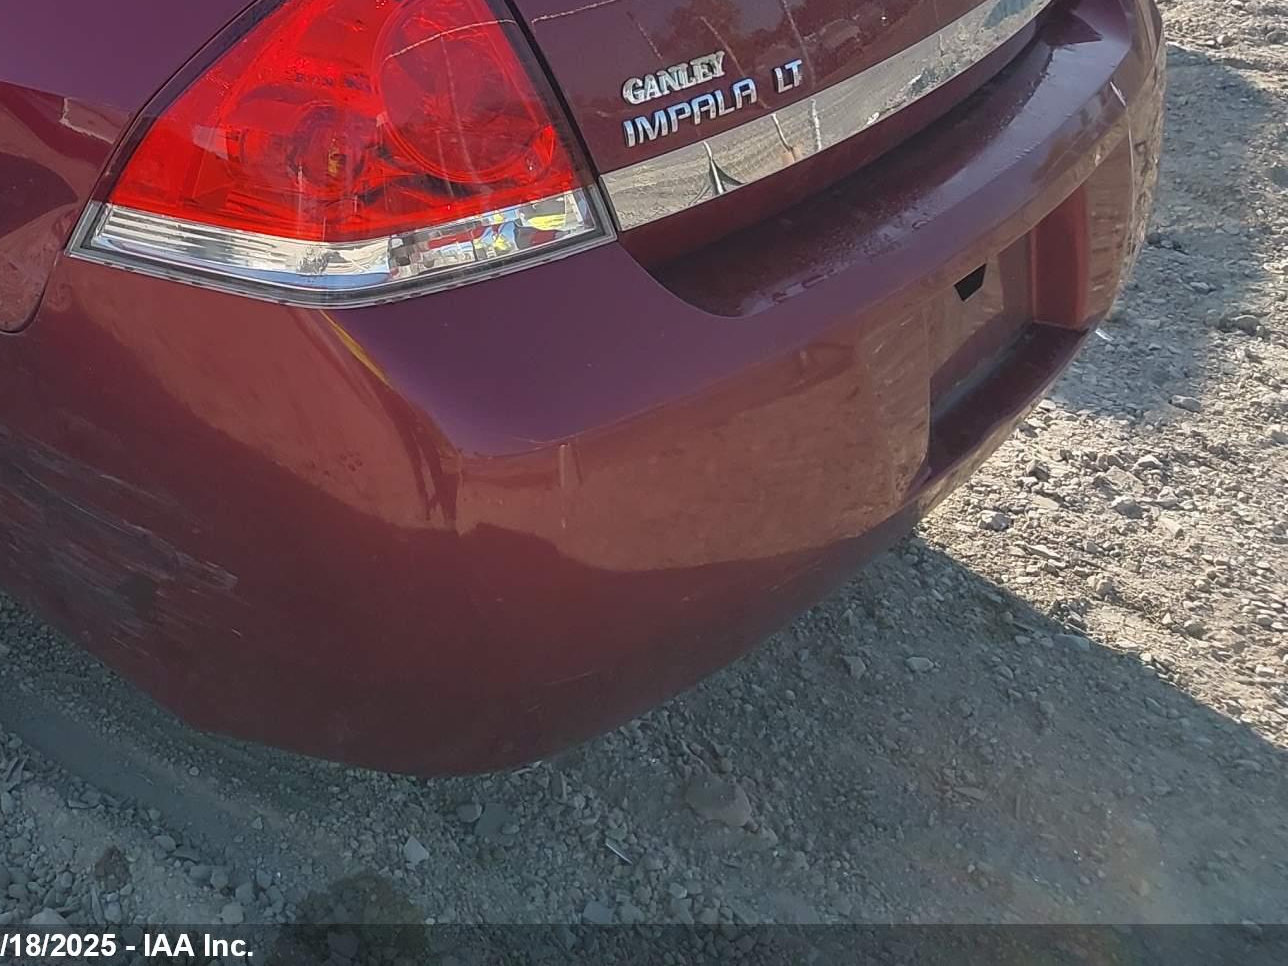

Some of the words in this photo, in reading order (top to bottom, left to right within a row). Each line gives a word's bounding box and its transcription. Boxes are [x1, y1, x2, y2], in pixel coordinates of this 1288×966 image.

[622, 50, 725, 105] GANLEY
[622, 77, 758, 148] IMPALA
[773, 58, 803, 94] LT
